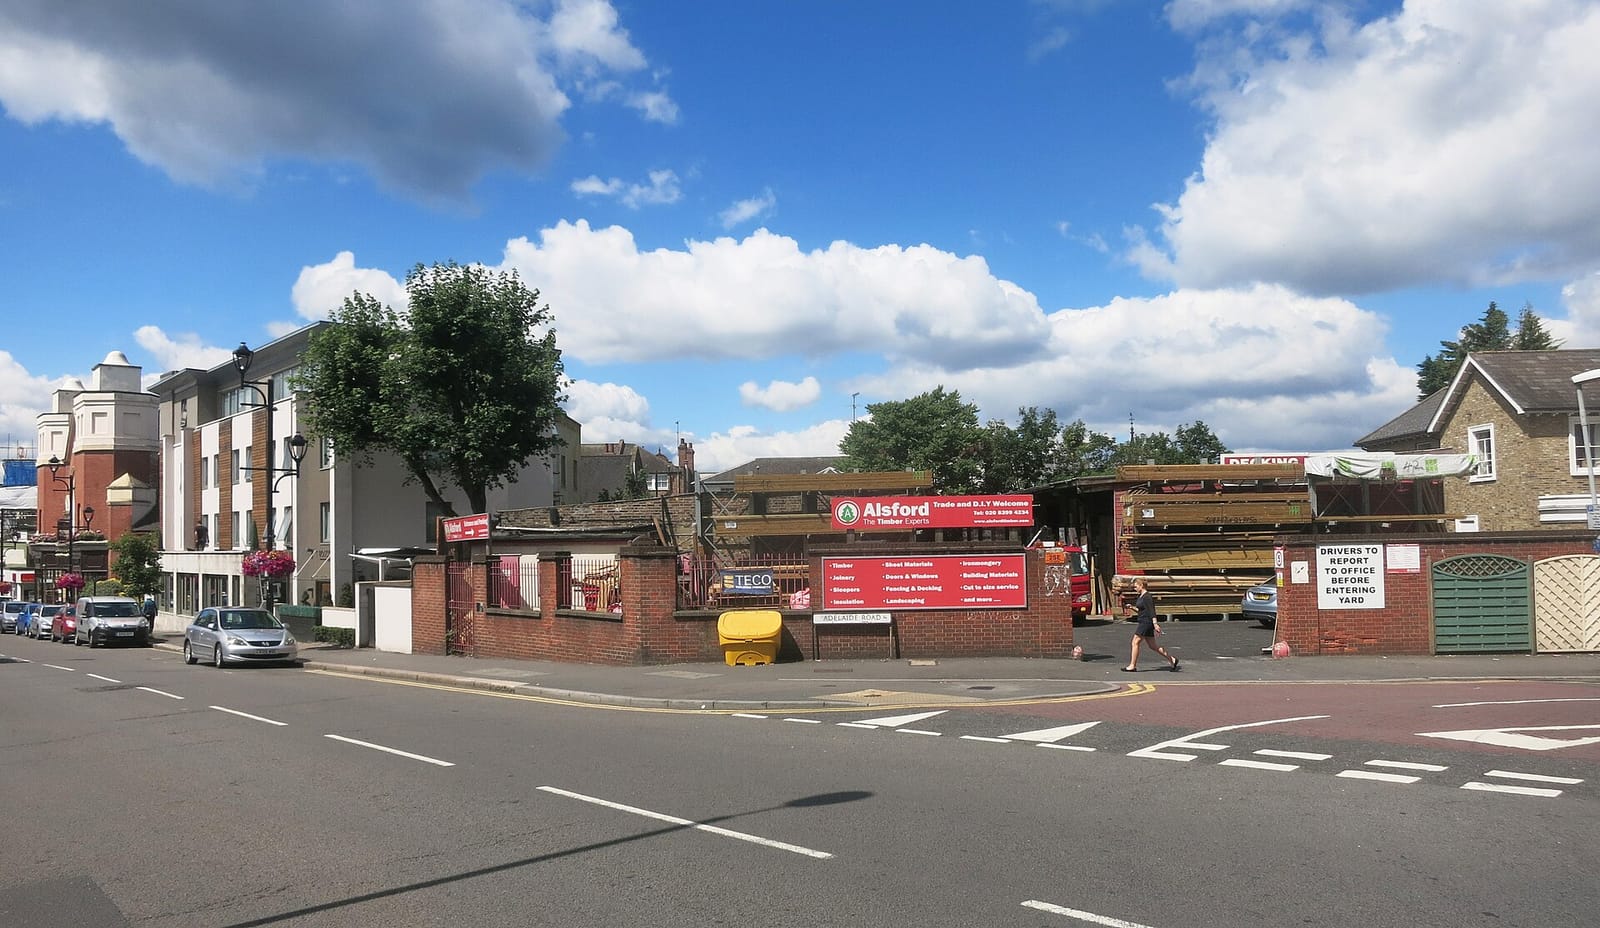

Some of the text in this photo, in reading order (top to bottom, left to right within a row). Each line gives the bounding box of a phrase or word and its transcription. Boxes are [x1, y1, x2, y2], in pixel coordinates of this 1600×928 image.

[863, 502, 929, 517] Alsford
[905, 518, 930, 526] Experts
[1320, 547, 1362, 555] DRIVERS
[1330, 557, 1369, 565] REPORT
[735, 574, 772, 585] TECO
[1339, 596, 1365, 604] YARD
